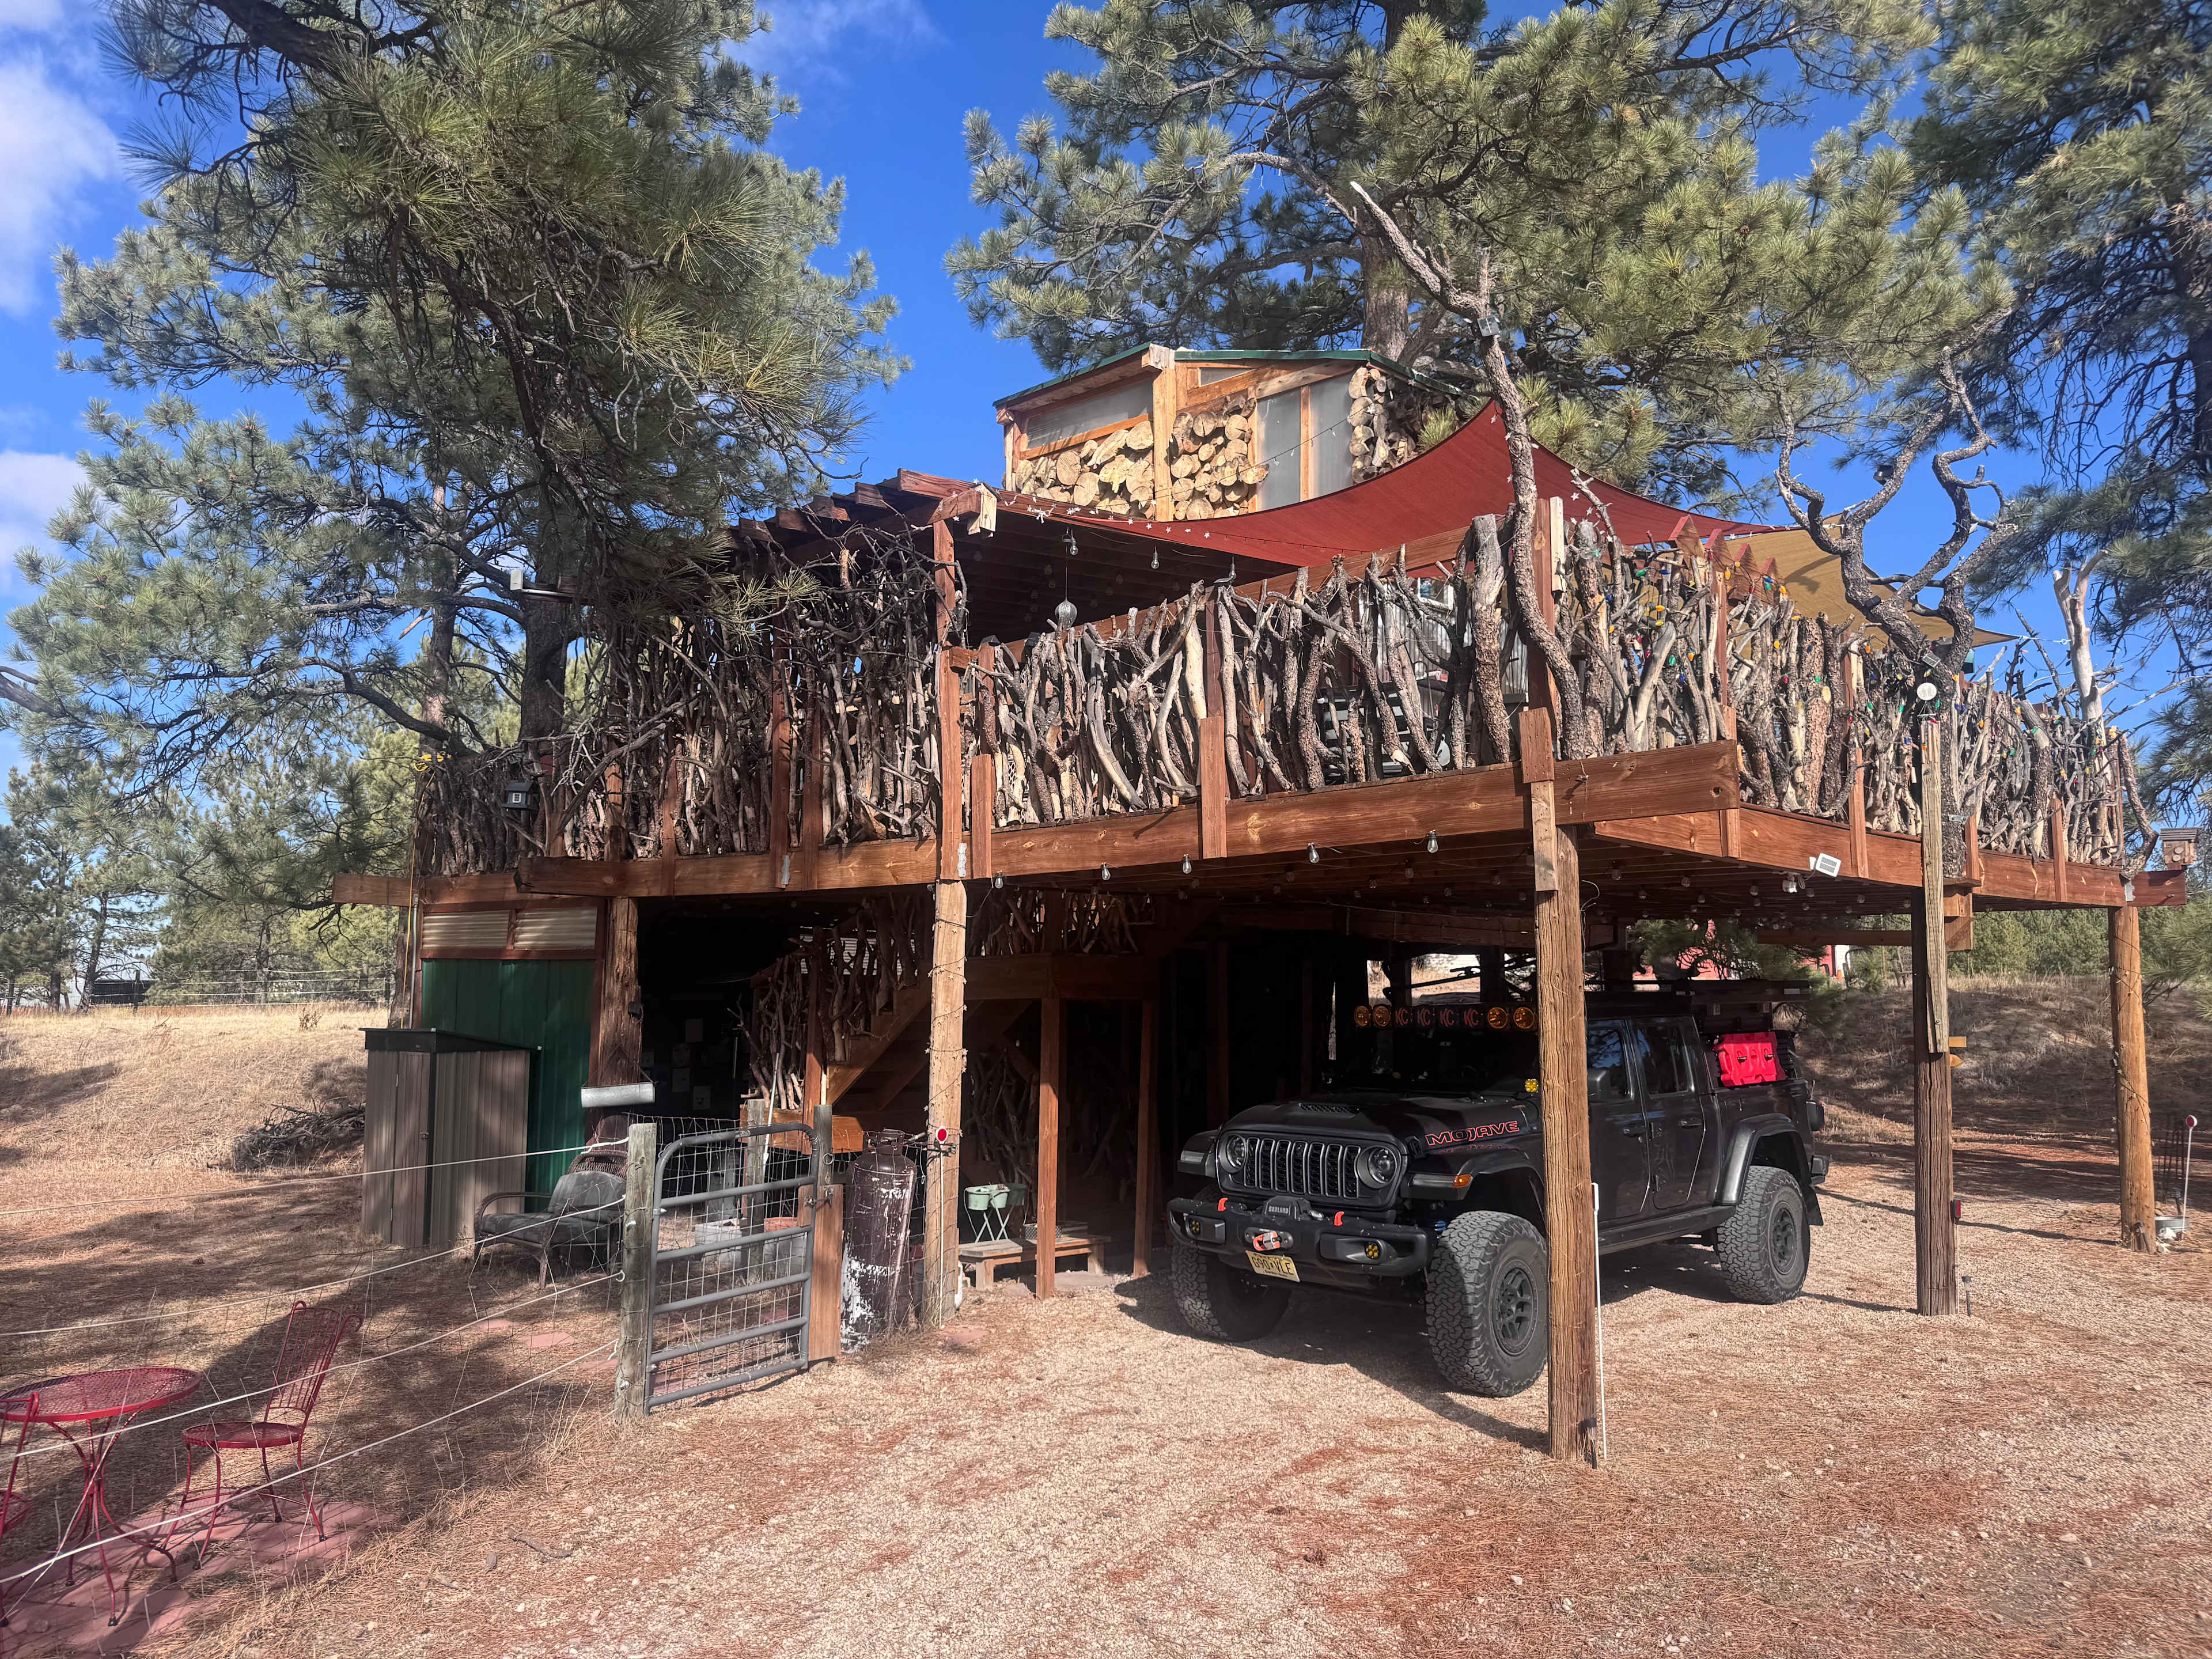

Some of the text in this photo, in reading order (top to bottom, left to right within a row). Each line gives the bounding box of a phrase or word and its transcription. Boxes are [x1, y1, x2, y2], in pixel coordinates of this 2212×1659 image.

[1395, 1008, 1409, 1027] KC
[1417, 1008, 1431, 1027] KC
[1440, 1008, 1455, 1027] KC
[1464, 1008, 1479, 1027] KC
[1425, 1120, 1520, 1146] MOJAVE
